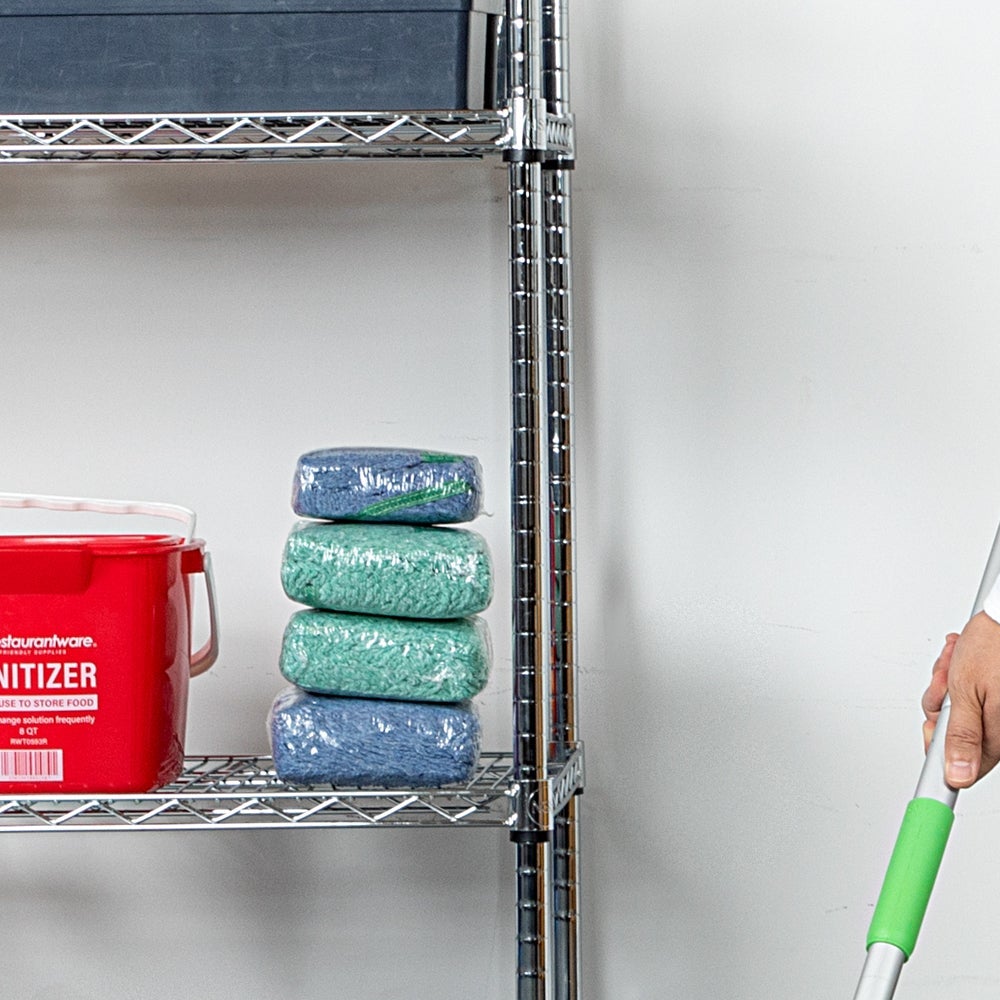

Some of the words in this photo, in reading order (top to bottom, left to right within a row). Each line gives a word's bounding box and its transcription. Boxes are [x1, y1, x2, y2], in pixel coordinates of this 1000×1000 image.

[0, 634, 97, 648] staurantware.
[19, 699, 31, 708] TO
[33, 699, 64, 707] STORE
[67, 698, 94, 707] FOOD
[22, 715, 54, 724] solution
[55, 714, 95, 725] frequently
[19, 727, 25, 735] 8
[26, 727, 38, 736] QT
